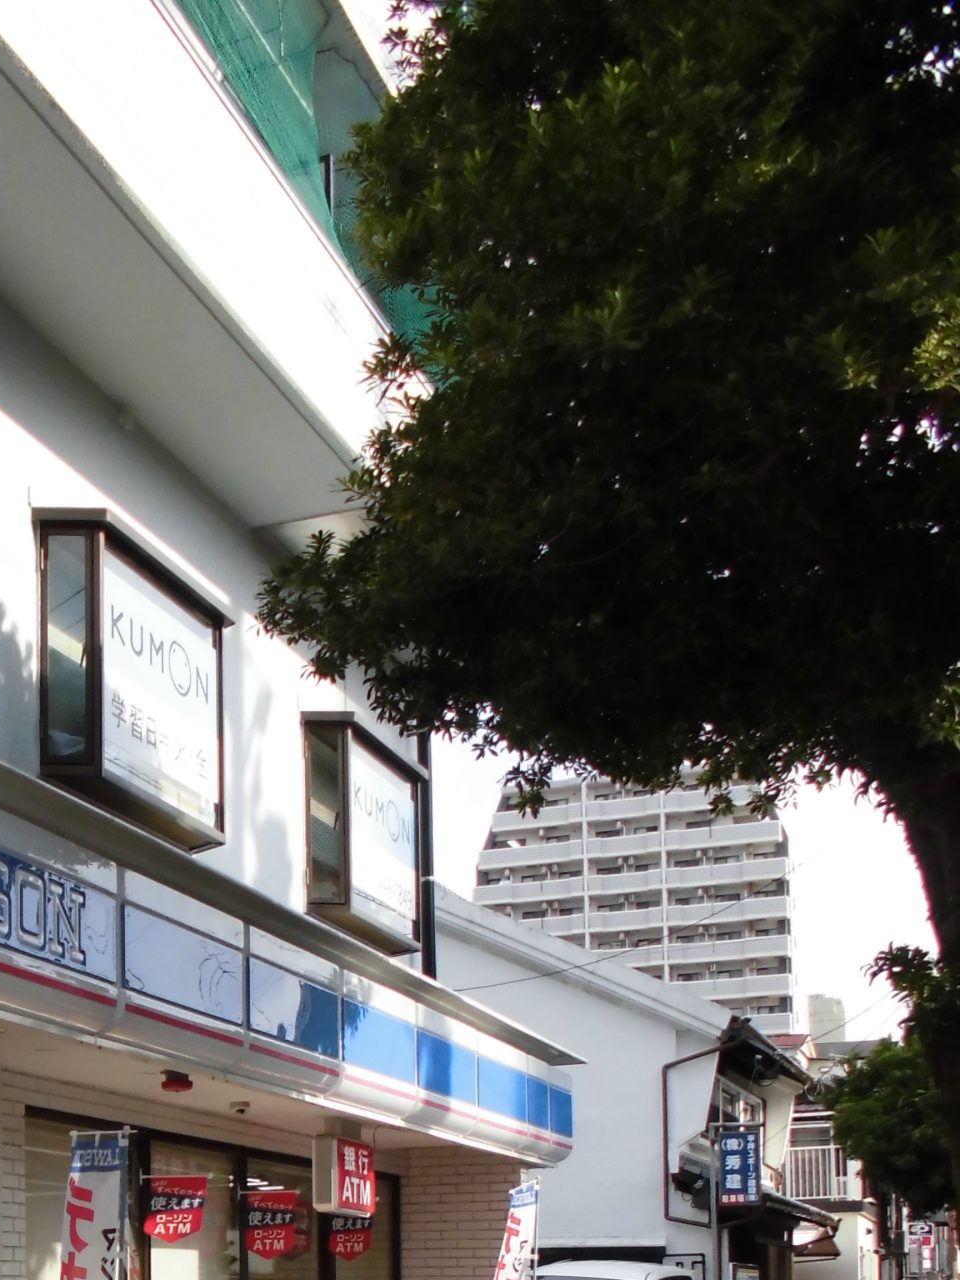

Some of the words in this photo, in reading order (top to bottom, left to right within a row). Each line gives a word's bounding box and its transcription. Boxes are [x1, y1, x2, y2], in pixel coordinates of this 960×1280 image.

[110, 604, 209, 705] KUMON
[353, 781, 410, 845] KUMON
[344, 1145, 369, 1175] 銀行
[342, 1175, 371, 1206] ATM
[150, 1196, 203, 1211] 使えます
[156, 1214, 193, 1223] ローソン
[248, 1211, 293, 1226] 使えます
[332, 1217, 371, 1231] 使えます
[153, 1223, 191, 1235] ATM
[254, 1229, 286, 1239] ローソン
[337, 1233, 364, 1242] ローソン
[253, 1239, 285, 1251] ATM
[335, 1242, 364, 1253] ATM
